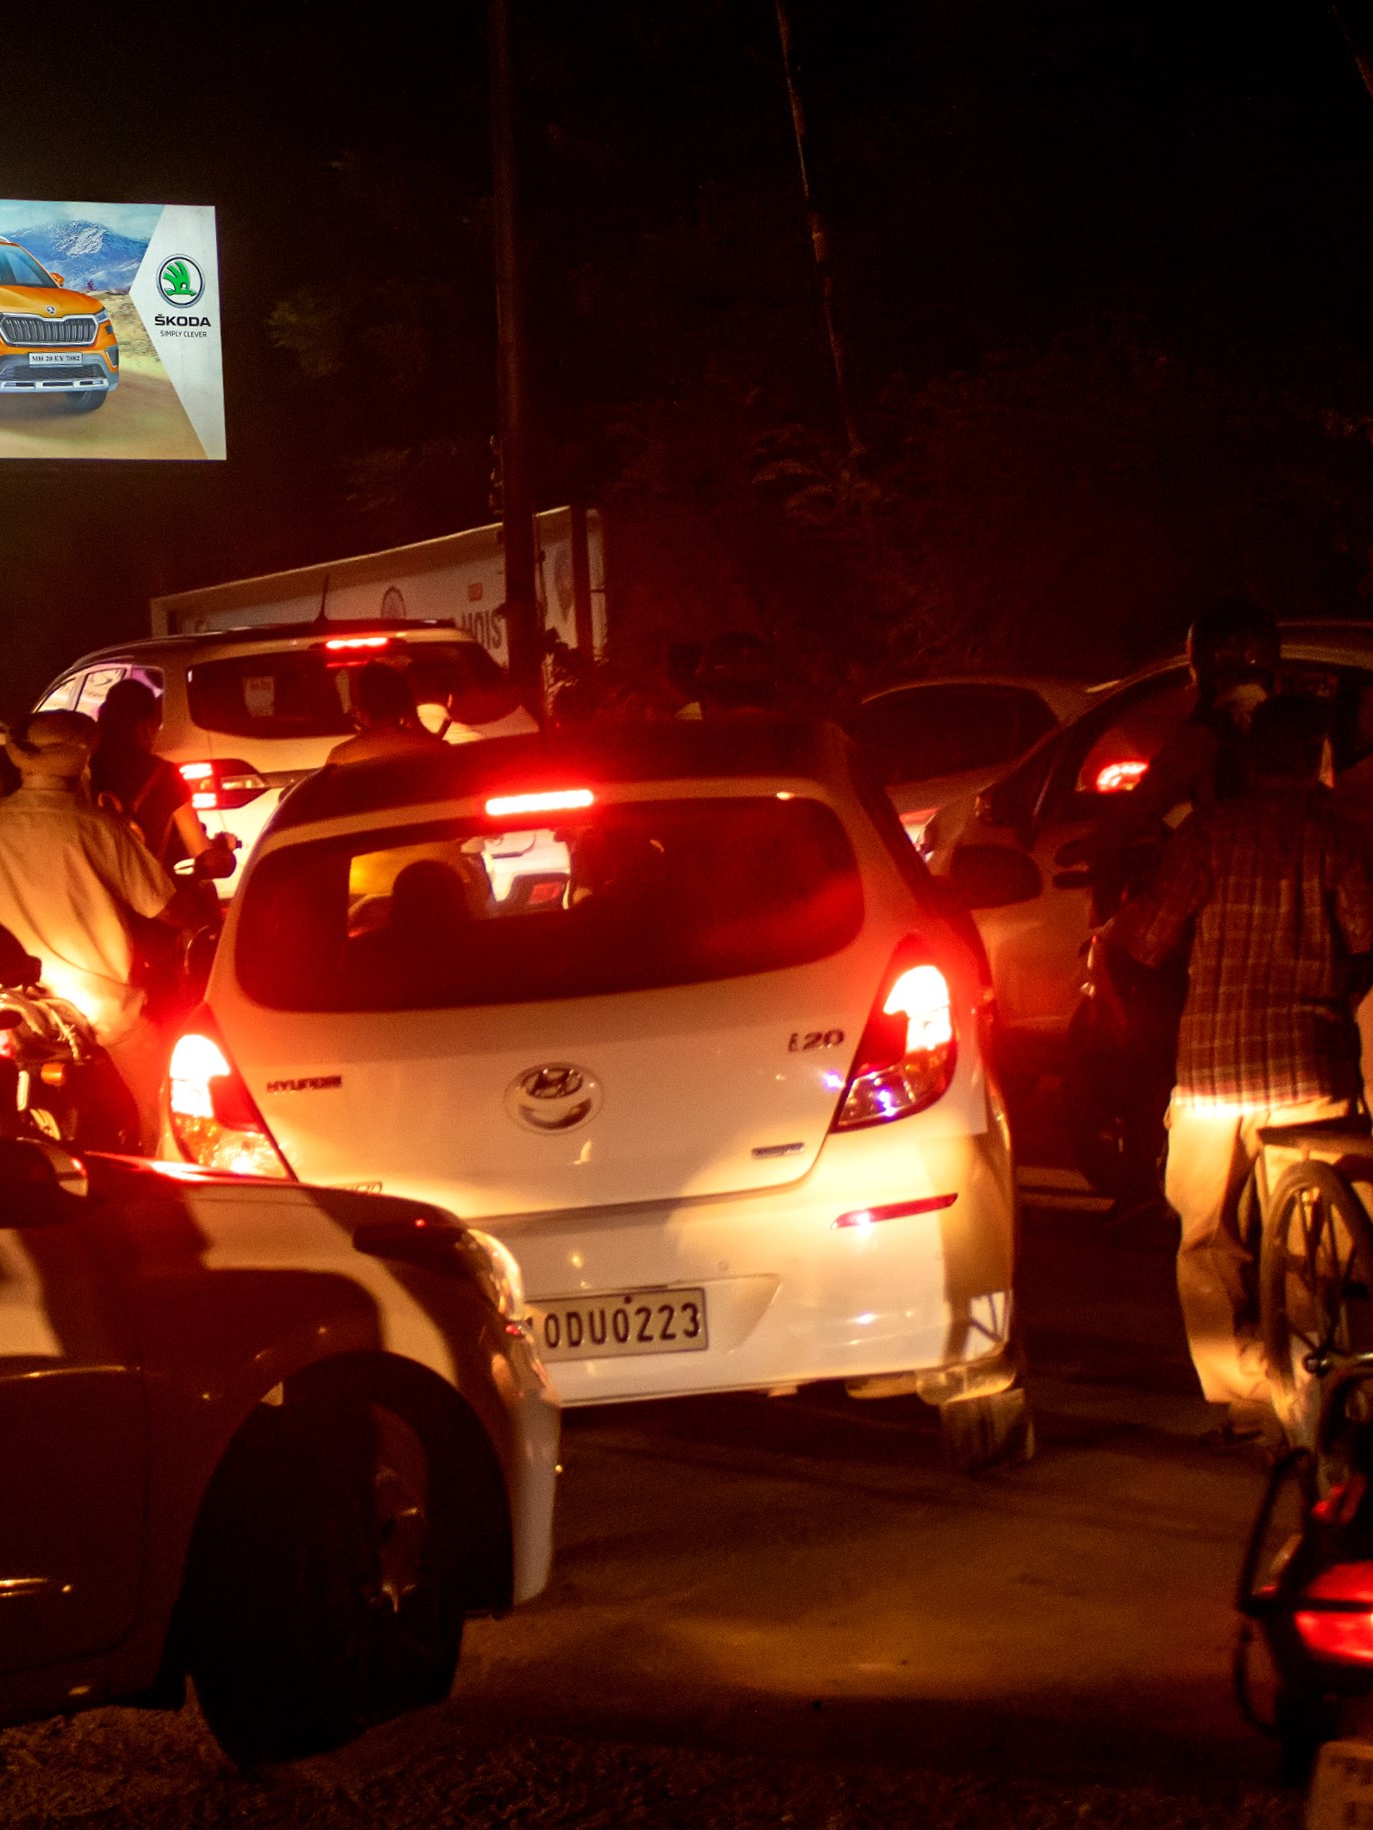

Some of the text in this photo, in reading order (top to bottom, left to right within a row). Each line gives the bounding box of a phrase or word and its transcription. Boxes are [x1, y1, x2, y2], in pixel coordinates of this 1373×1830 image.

[154, 313, 212, 327] ŠKODA
[160, 330, 183, 338] SIMPLY
[526, 1302, 701, 1348] 0DU0223
